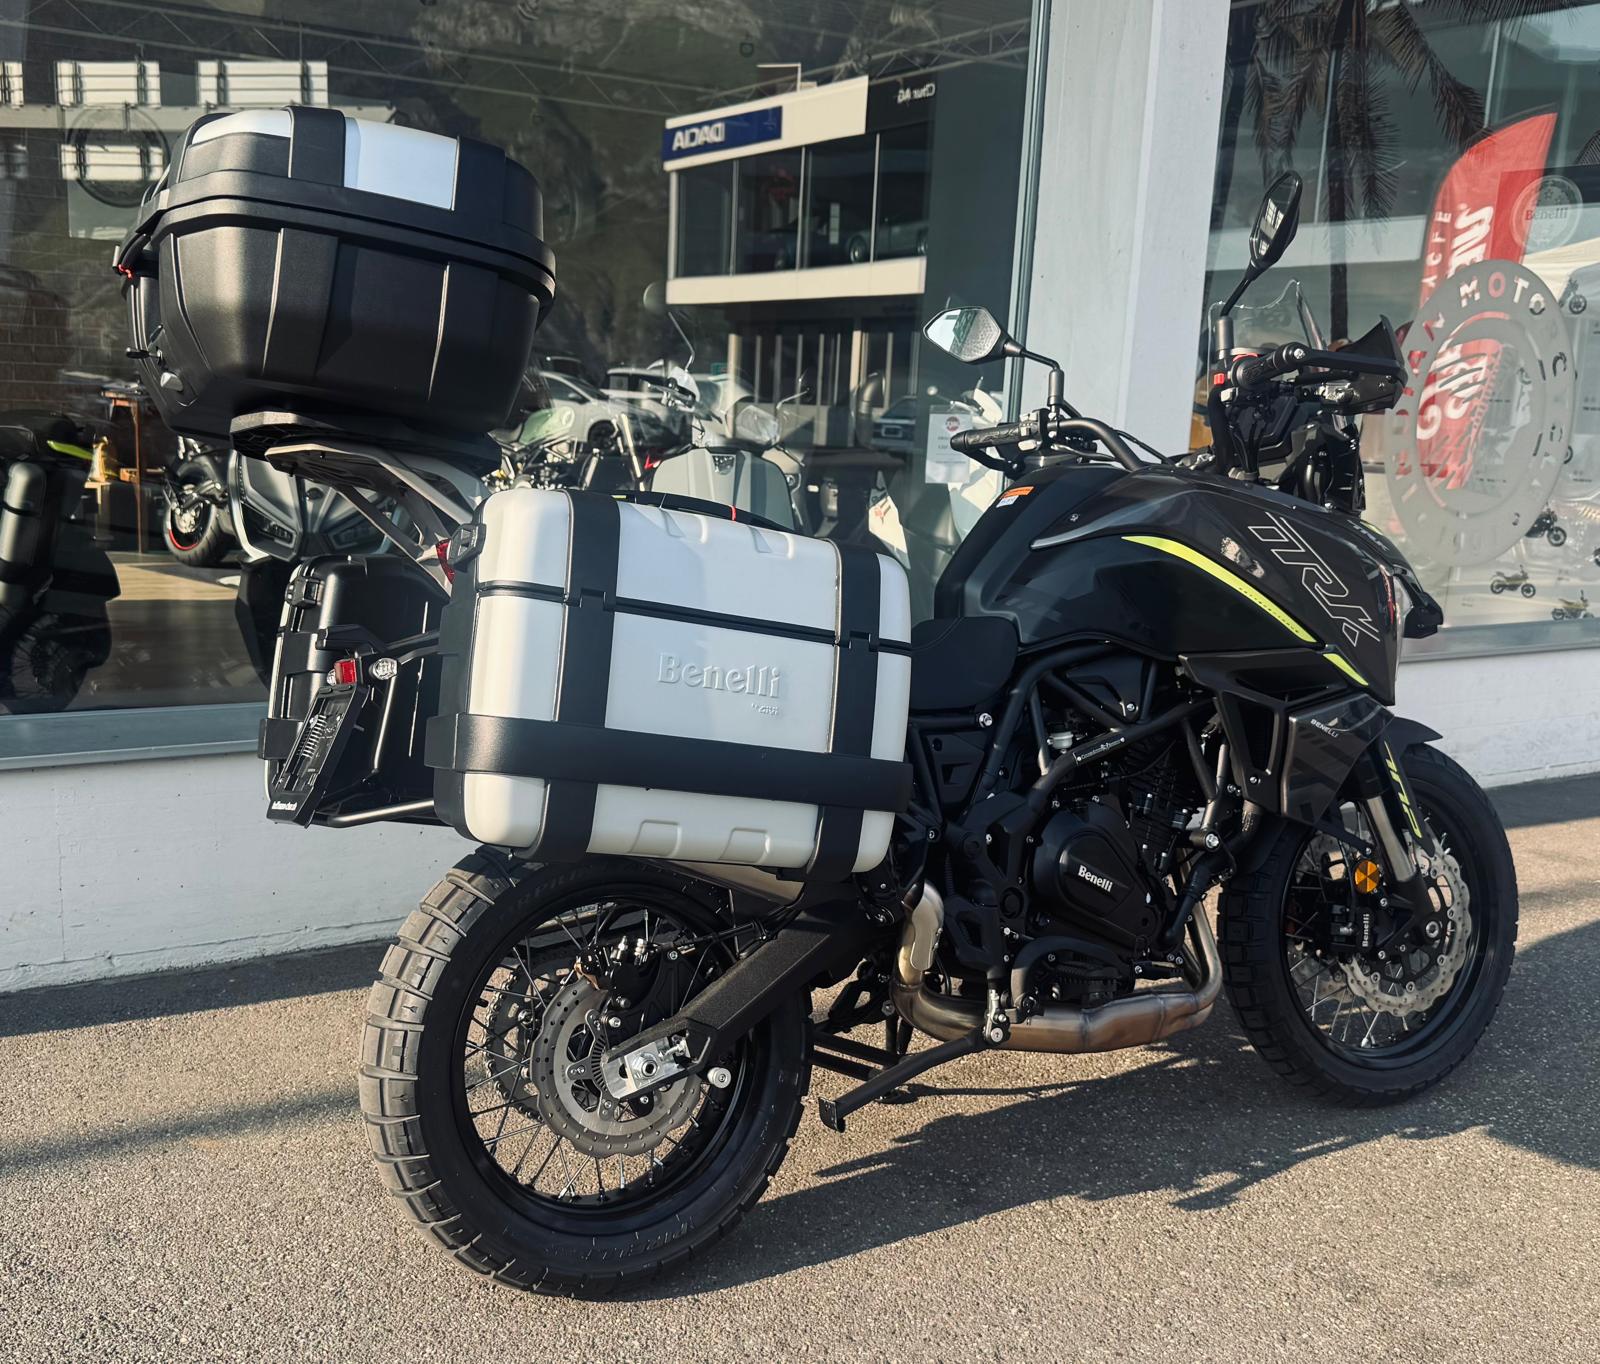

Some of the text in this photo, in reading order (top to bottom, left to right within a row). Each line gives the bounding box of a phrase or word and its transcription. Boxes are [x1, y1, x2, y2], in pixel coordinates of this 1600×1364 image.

[1525, 206, 1569, 221] Benelli
[657, 651, 781, 699] Benelli
[1078, 864, 1113, 893] Benelli
[1361, 913, 1370, 947] Benelli
